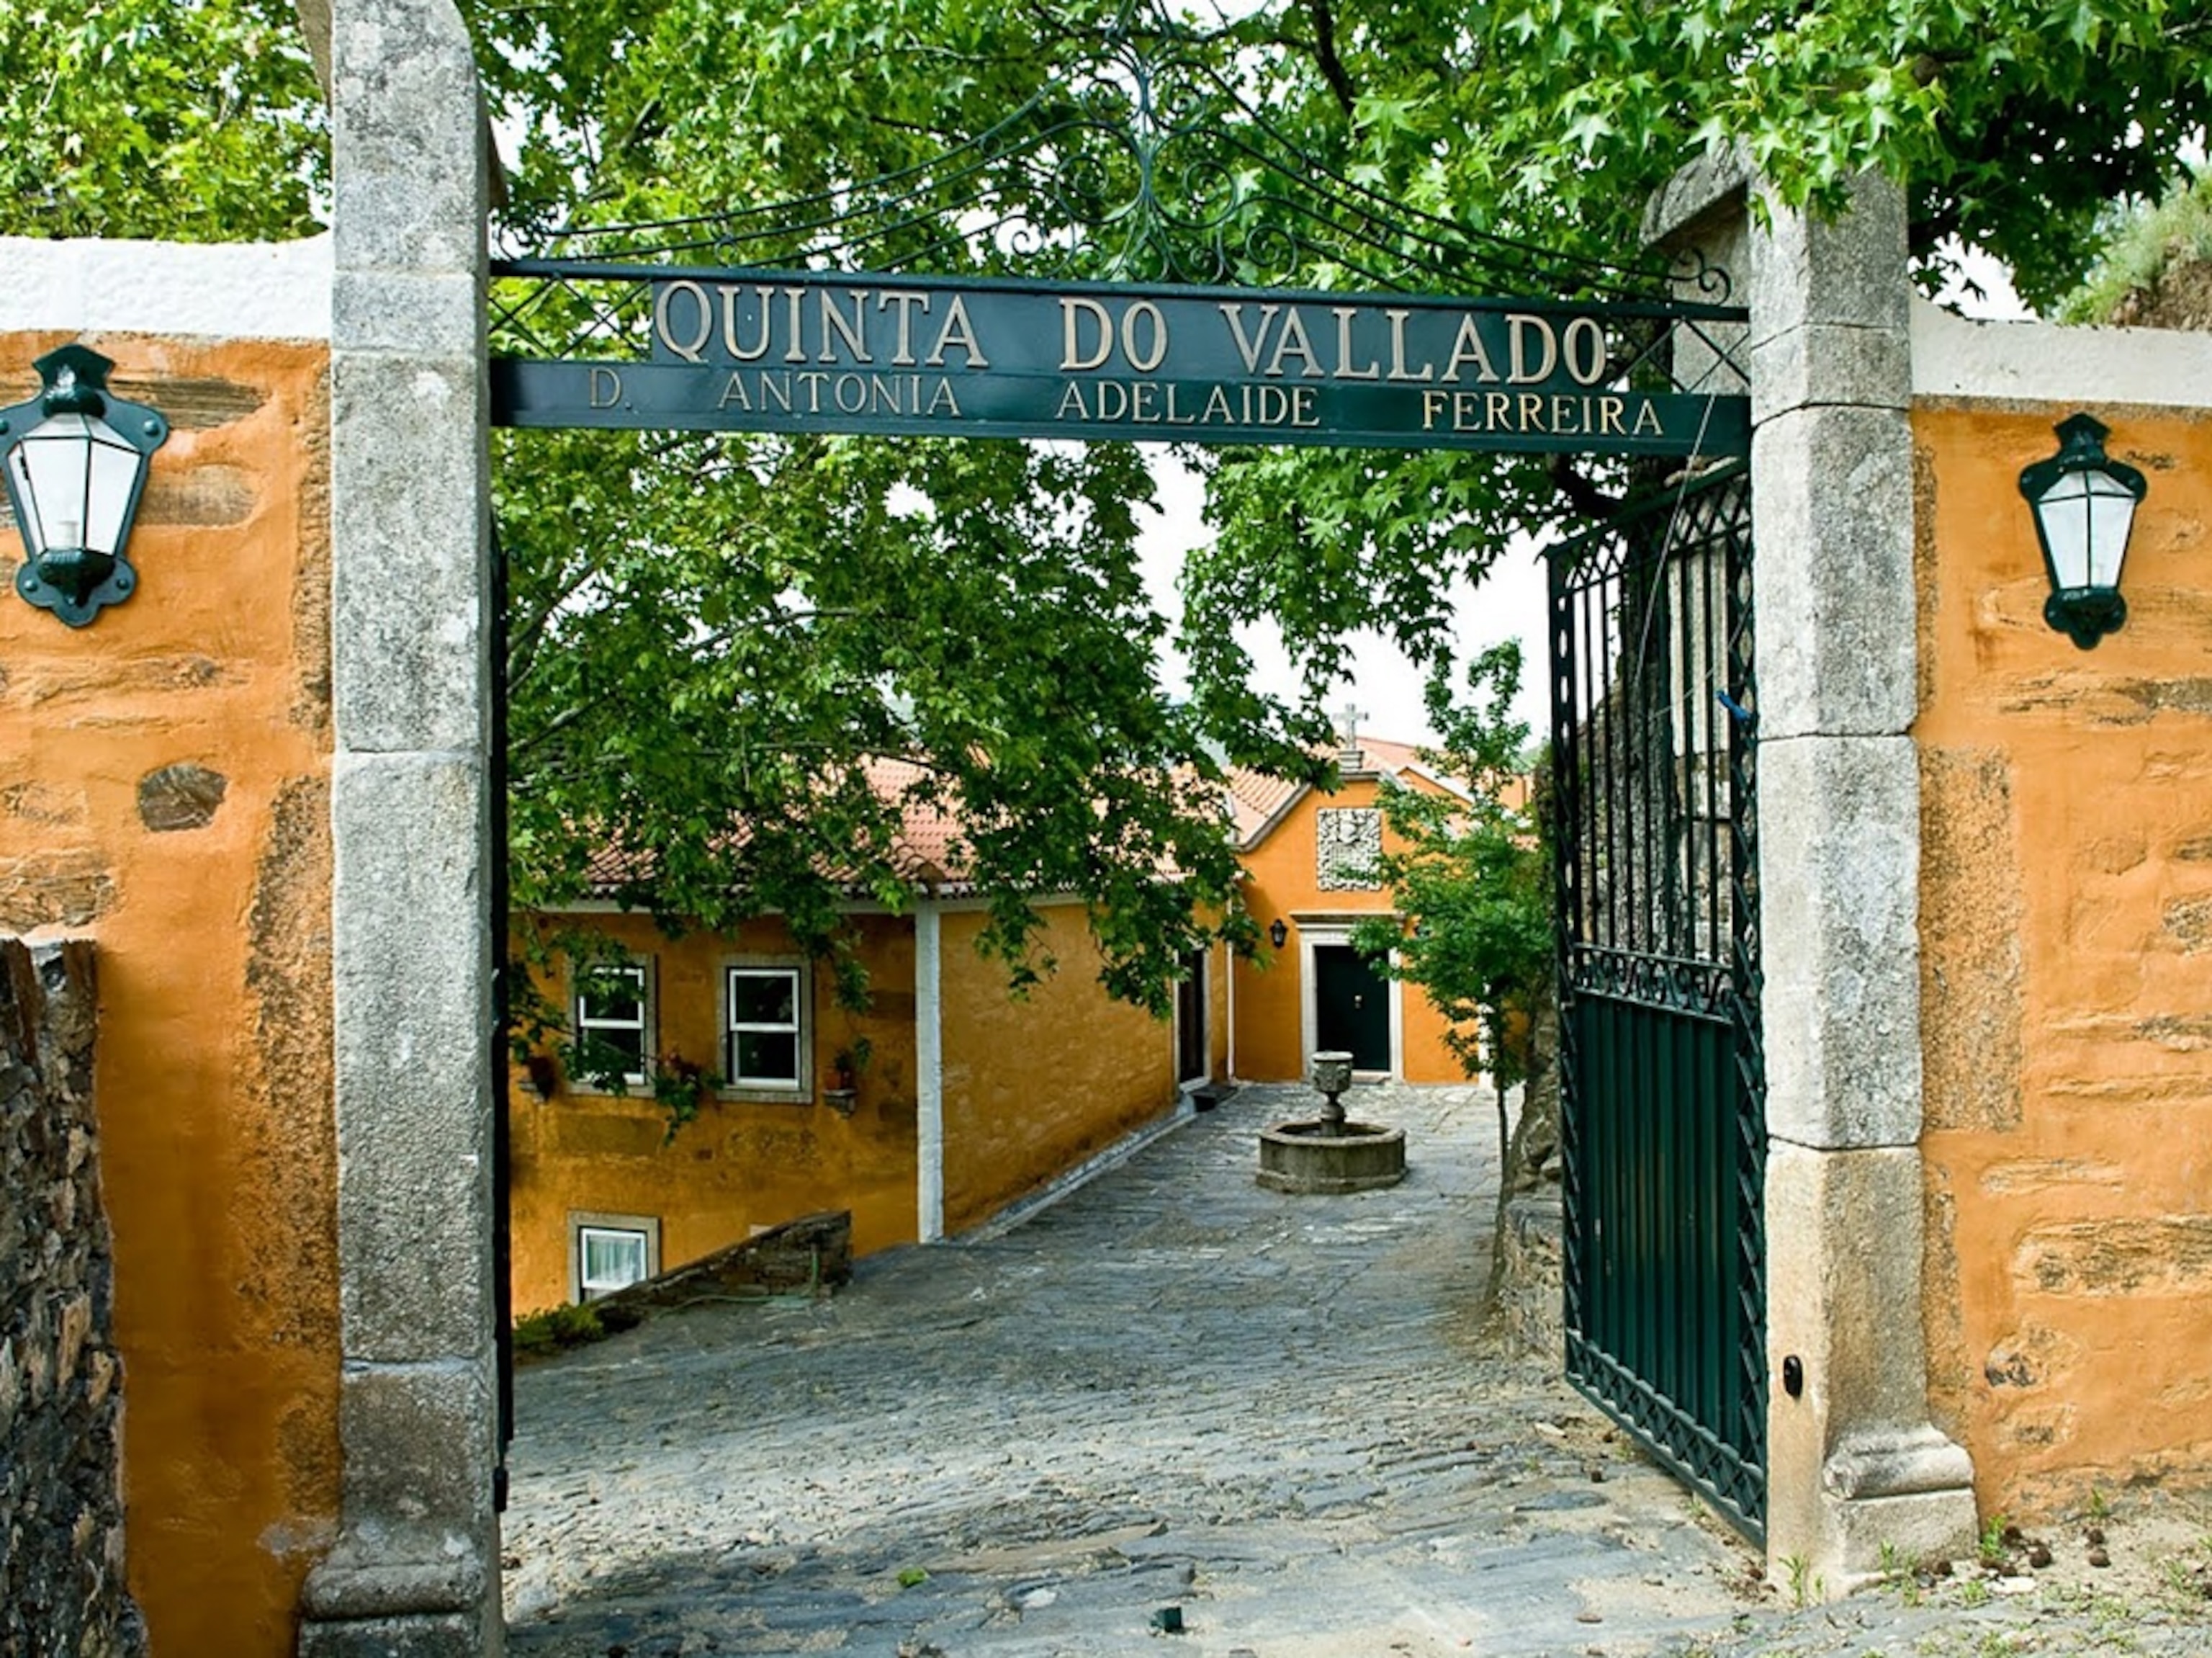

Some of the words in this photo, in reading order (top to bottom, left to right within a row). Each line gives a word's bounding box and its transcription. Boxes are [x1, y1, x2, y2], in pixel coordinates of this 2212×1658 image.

[655, 279, 989, 367] QUINTA
[1059, 297, 1168, 372] DO
[1220, 303, 1607, 385] VALLADO
[589, 368, 632, 410] D.
[718, 370, 961, 417] ANTONIA
[1055, 380, 1320, 426] ADELAIDE
[1421, 390, 1664, 436] FERREIRA
